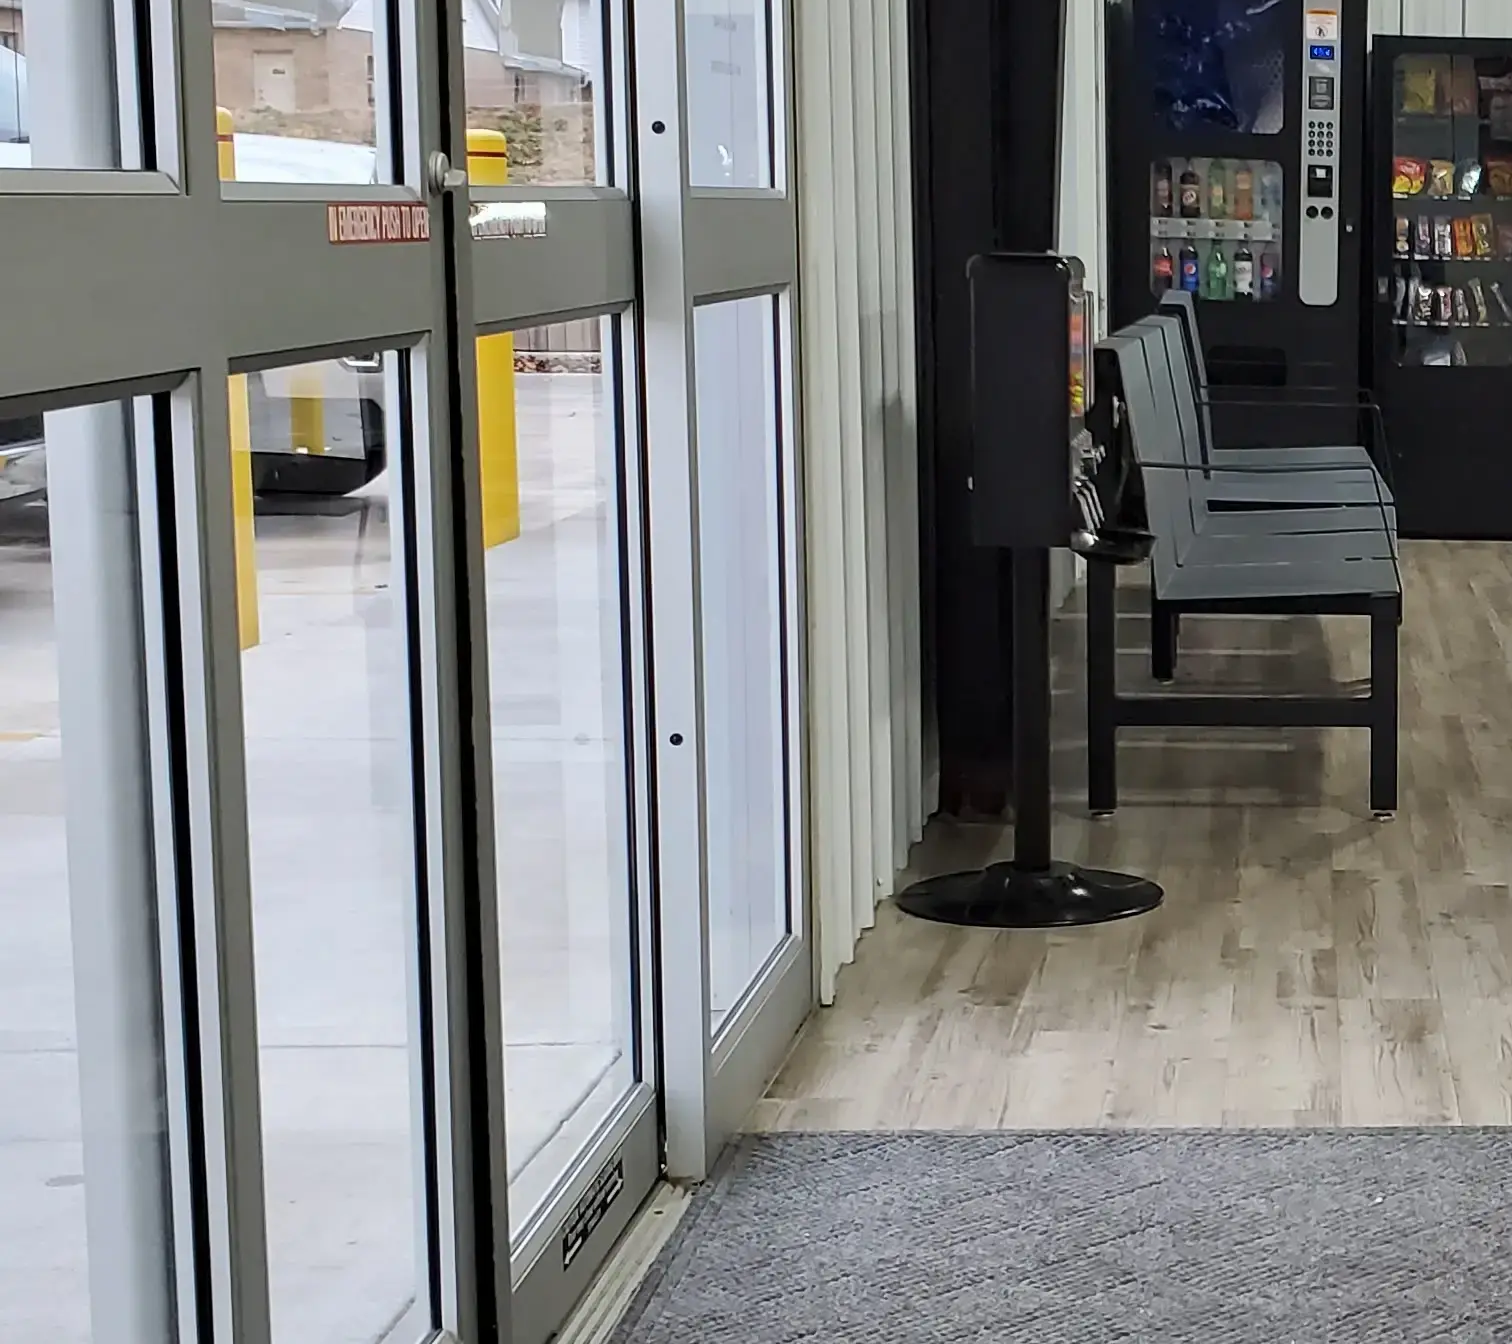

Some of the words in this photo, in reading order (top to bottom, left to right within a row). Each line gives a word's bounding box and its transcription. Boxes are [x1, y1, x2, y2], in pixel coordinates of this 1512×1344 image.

[338, 205, 380, 241] EMERGENCY
[381, 205, 402, 239] PUSH
[401, 205, 411, 239] TO
